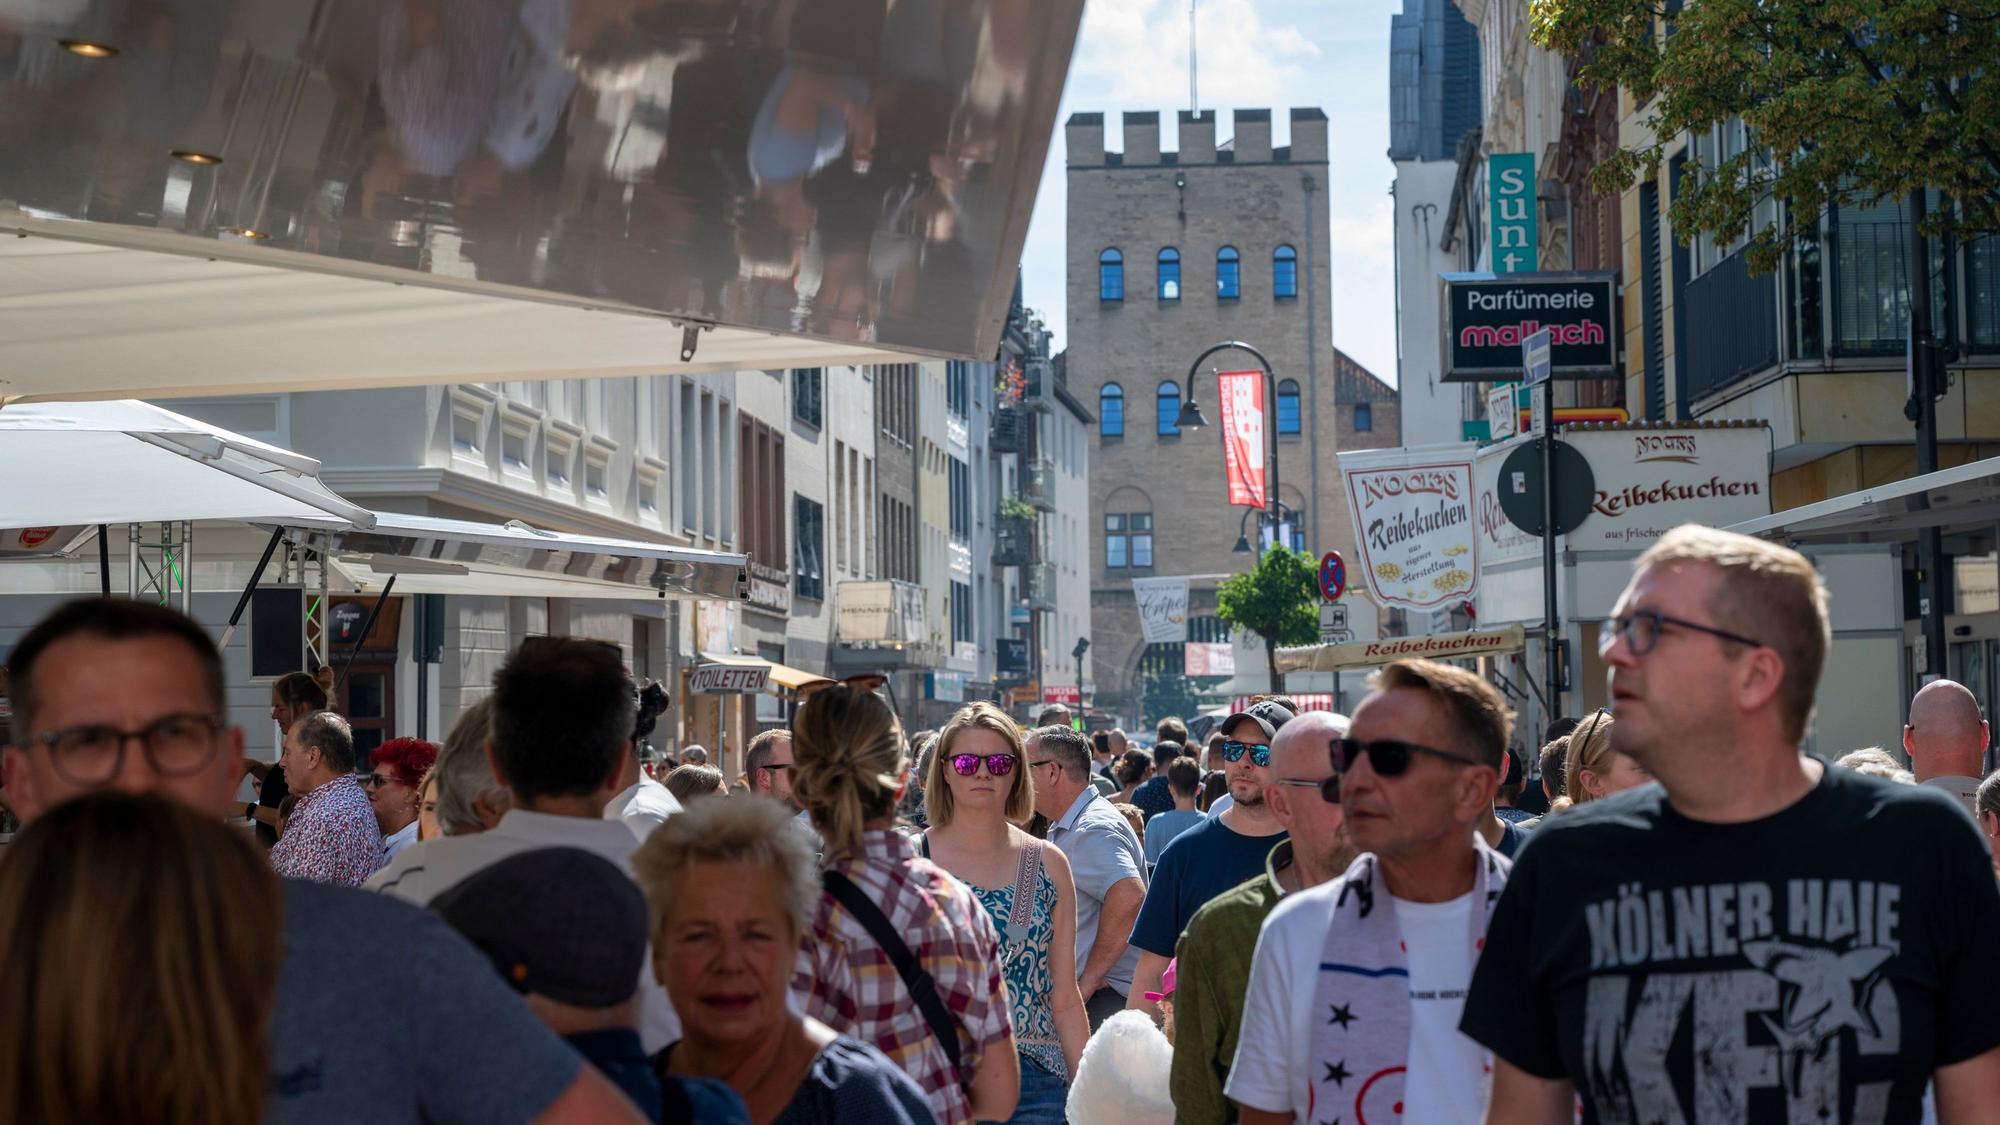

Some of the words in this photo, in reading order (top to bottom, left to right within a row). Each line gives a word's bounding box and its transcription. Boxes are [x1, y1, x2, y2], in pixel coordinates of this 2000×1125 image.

[1467, 289, 1594, 310] Parfümerie
[1591, 475, 1760, 518] Reibekuchen
[1368, 499, 1467, 551] Reibekuchen
[1604, 530, 1623, 539] aus
[1405, 552, 1432, 566] eigener
[1407, 544, 1421, 553] aus
[1401, 559, 1456, 584] Herstellung
[1364, 635, 1502, 657] Reibekuchen
[697, 669, 769, 689] TOILETTEN
[1584, 880, 1774, 971] KÖLNER
[1787, 877, 1902, 957] HAIE
